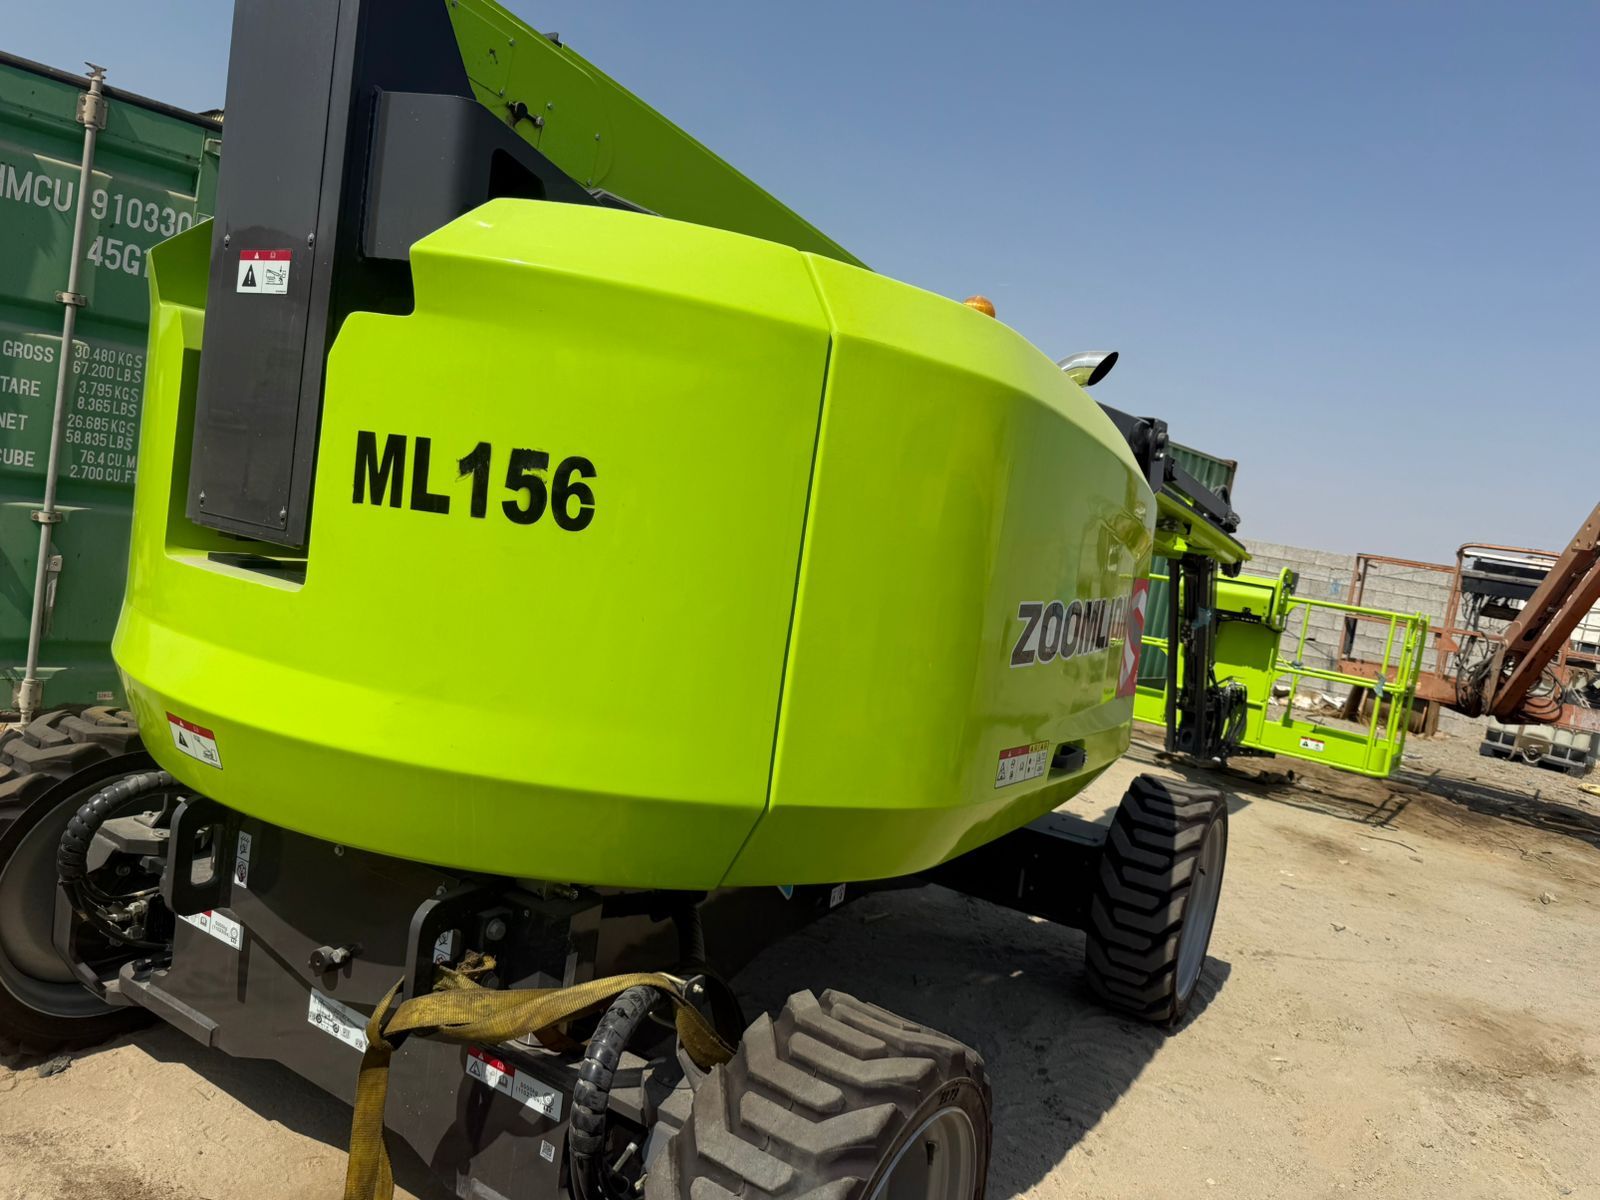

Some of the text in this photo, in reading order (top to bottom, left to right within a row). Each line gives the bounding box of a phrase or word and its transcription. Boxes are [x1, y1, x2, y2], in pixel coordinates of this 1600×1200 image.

[0, 164, 192, 237] MCU 910330
[3, 340, 143, 368] GROSS 30.480 KGS
[73, 360, 142, 383] 67.200 LBS
[0, 376, 139, 402] TARE 3.795 KGS
[77, 396, 137, 418] 8.365 LBS
[67, 414, 109, 431] 26.685
[111, 419, 136, 437] KGS
[66, 429, 133, 451] 58.835 LBS
[0, 448, 35, 468] UBE
[80, 449, 105, 465] 76.4
[70, 464, 104, 480] 2.700
[352, 430, 597, 532] ML156
